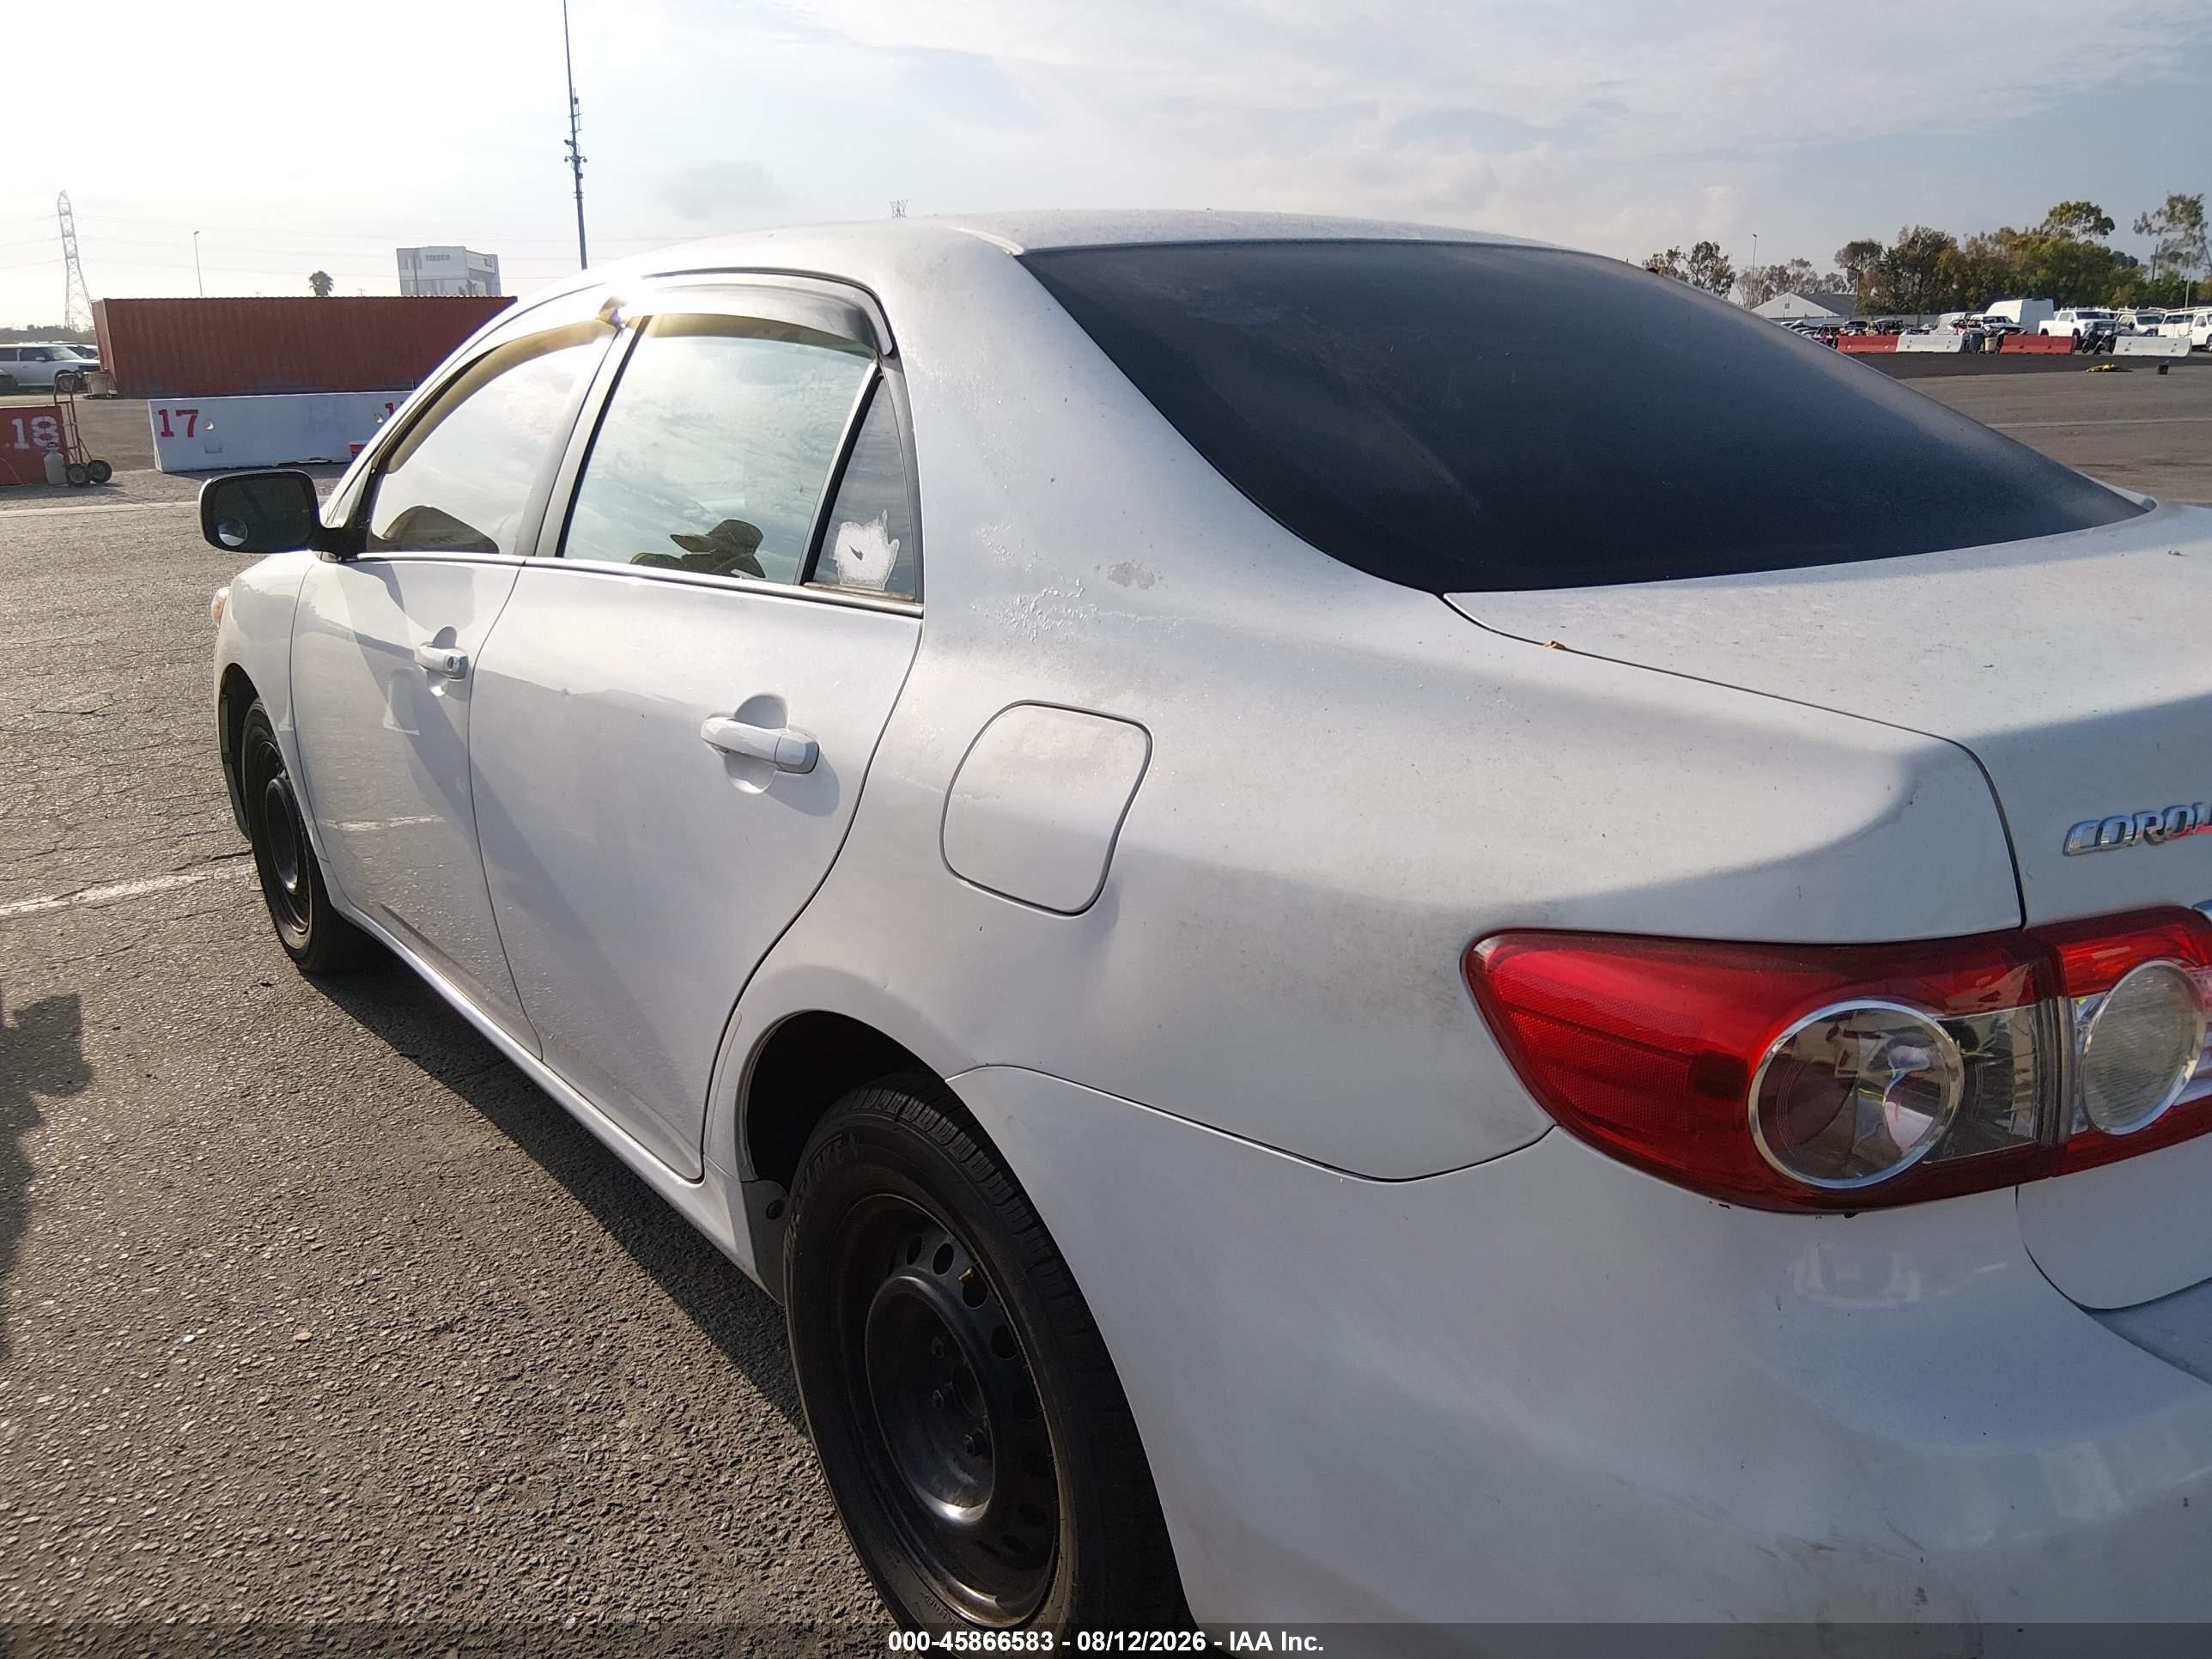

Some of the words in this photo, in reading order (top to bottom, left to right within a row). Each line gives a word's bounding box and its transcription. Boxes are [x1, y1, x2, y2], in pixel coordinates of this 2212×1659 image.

[12, 416, 60, 450] 18
[158, 409, 200, 438] 17
[2063, 802, 2212, 856] COROL
